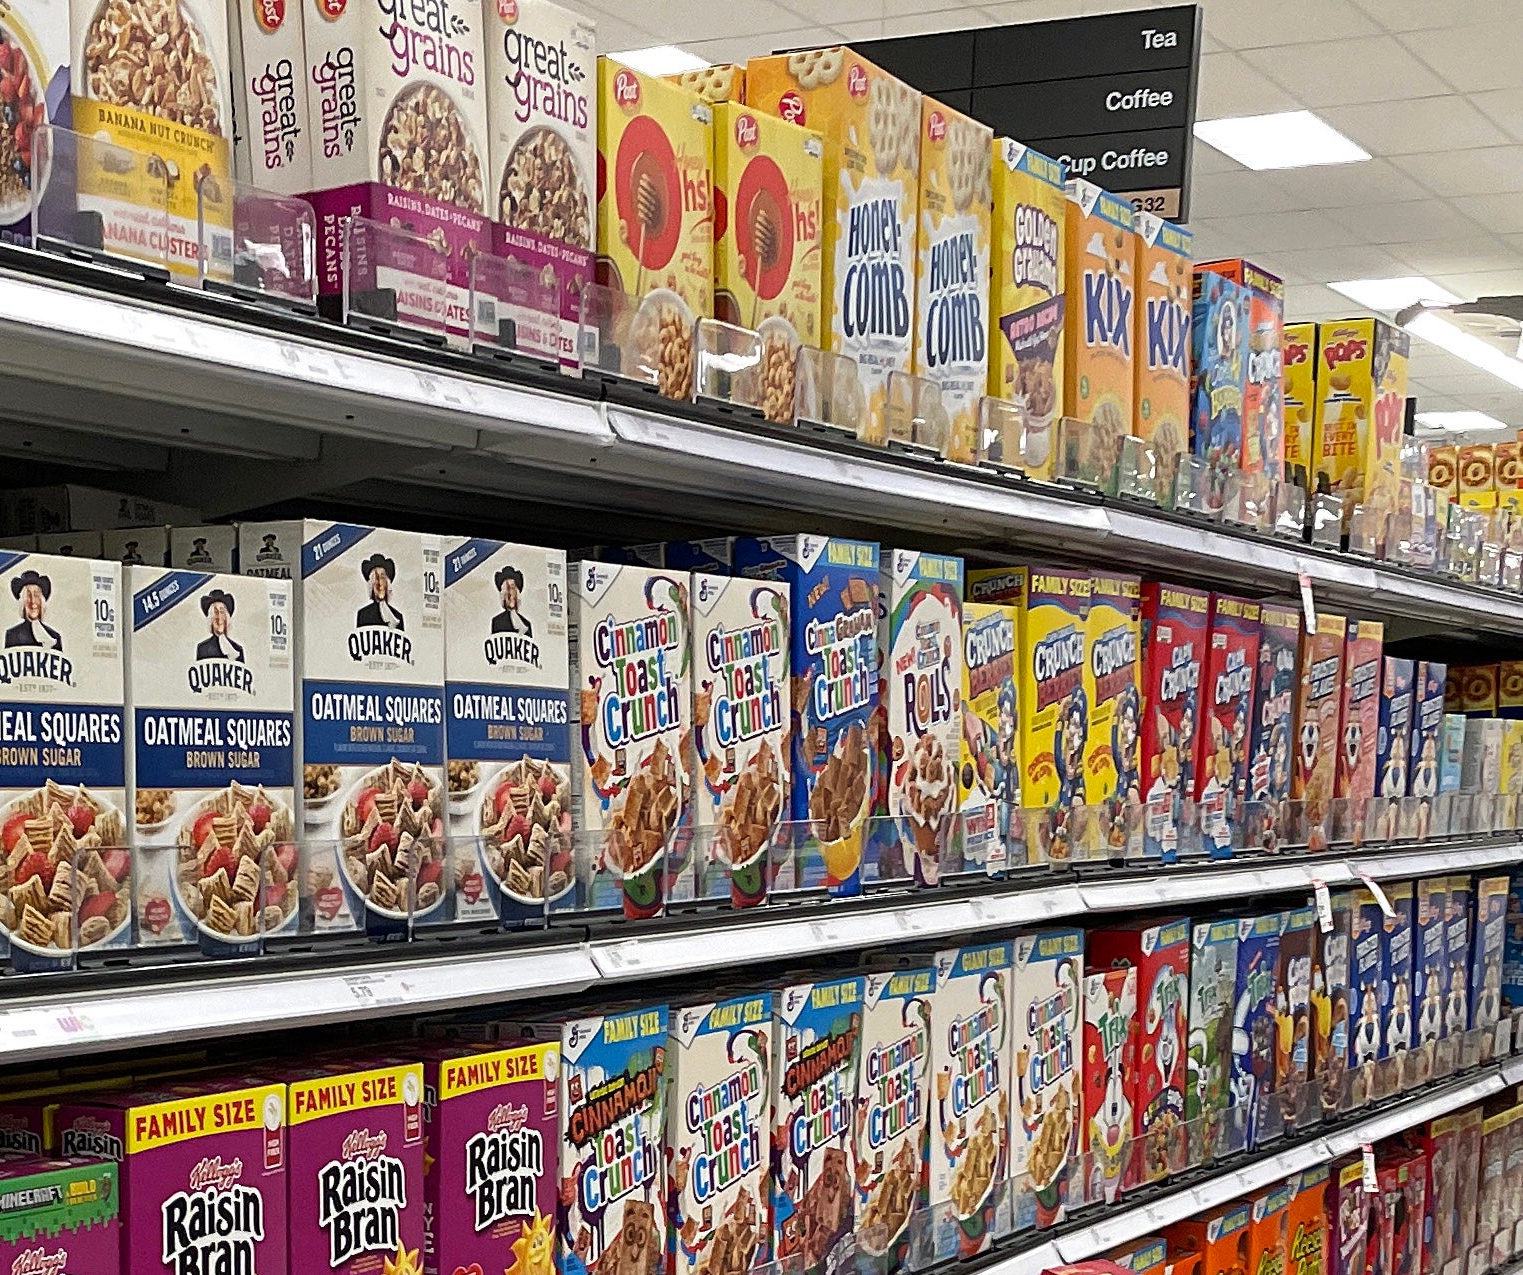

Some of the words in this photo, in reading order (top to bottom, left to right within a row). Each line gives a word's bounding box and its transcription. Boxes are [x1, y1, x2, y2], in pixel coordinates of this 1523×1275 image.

[1142, 29, 1177, 50] Tea
[1106, 89, 1173, 112] Coffee
[98, 108, 146, 134] BANANA
[149, 120, 171, 141] NUT
[174, 129, 215, 154] CRUNCH
[1101, 149, 1168, 171] Coffee
[348, 630, 414, 664] QUAKER
[484, 637, 541, 669] QUAKER
[1035, 633, 1085, 681] CRUNCH
[188, 662, 255, 695] QUAKER
[311, 693, 384, 722] OATMEAL
[386, 697, 442, 726] SQUARES
[453, 693, 516, 722] OATMEAL
[517, 697, 568, 725] SQUARES
[41, 712, 121, 747] SQUARES
[144, 716, 225, 747] OATMEAL
[227, 718, 291, 750] SQUARES
[603, 1015, 639, 1044] FAMILY
[639, 1011, 660, 1037] SIZE
[447, 1061, 501, 1090] FAMILY
[295, 1083, 358, 1115] FAMILY
[135, 1106, 207, 1143] FAMILY
[213, 1099, 256, 1128] SIZE
[468, 1132, 542, 1189] Raisin
[321, 1159, 406, 1221] Raisin
[477, 1175, 535, 1226] Bran
[165, 1189, 262, 1258] Raisin
[333, 1206, 398, 1261] Bran
